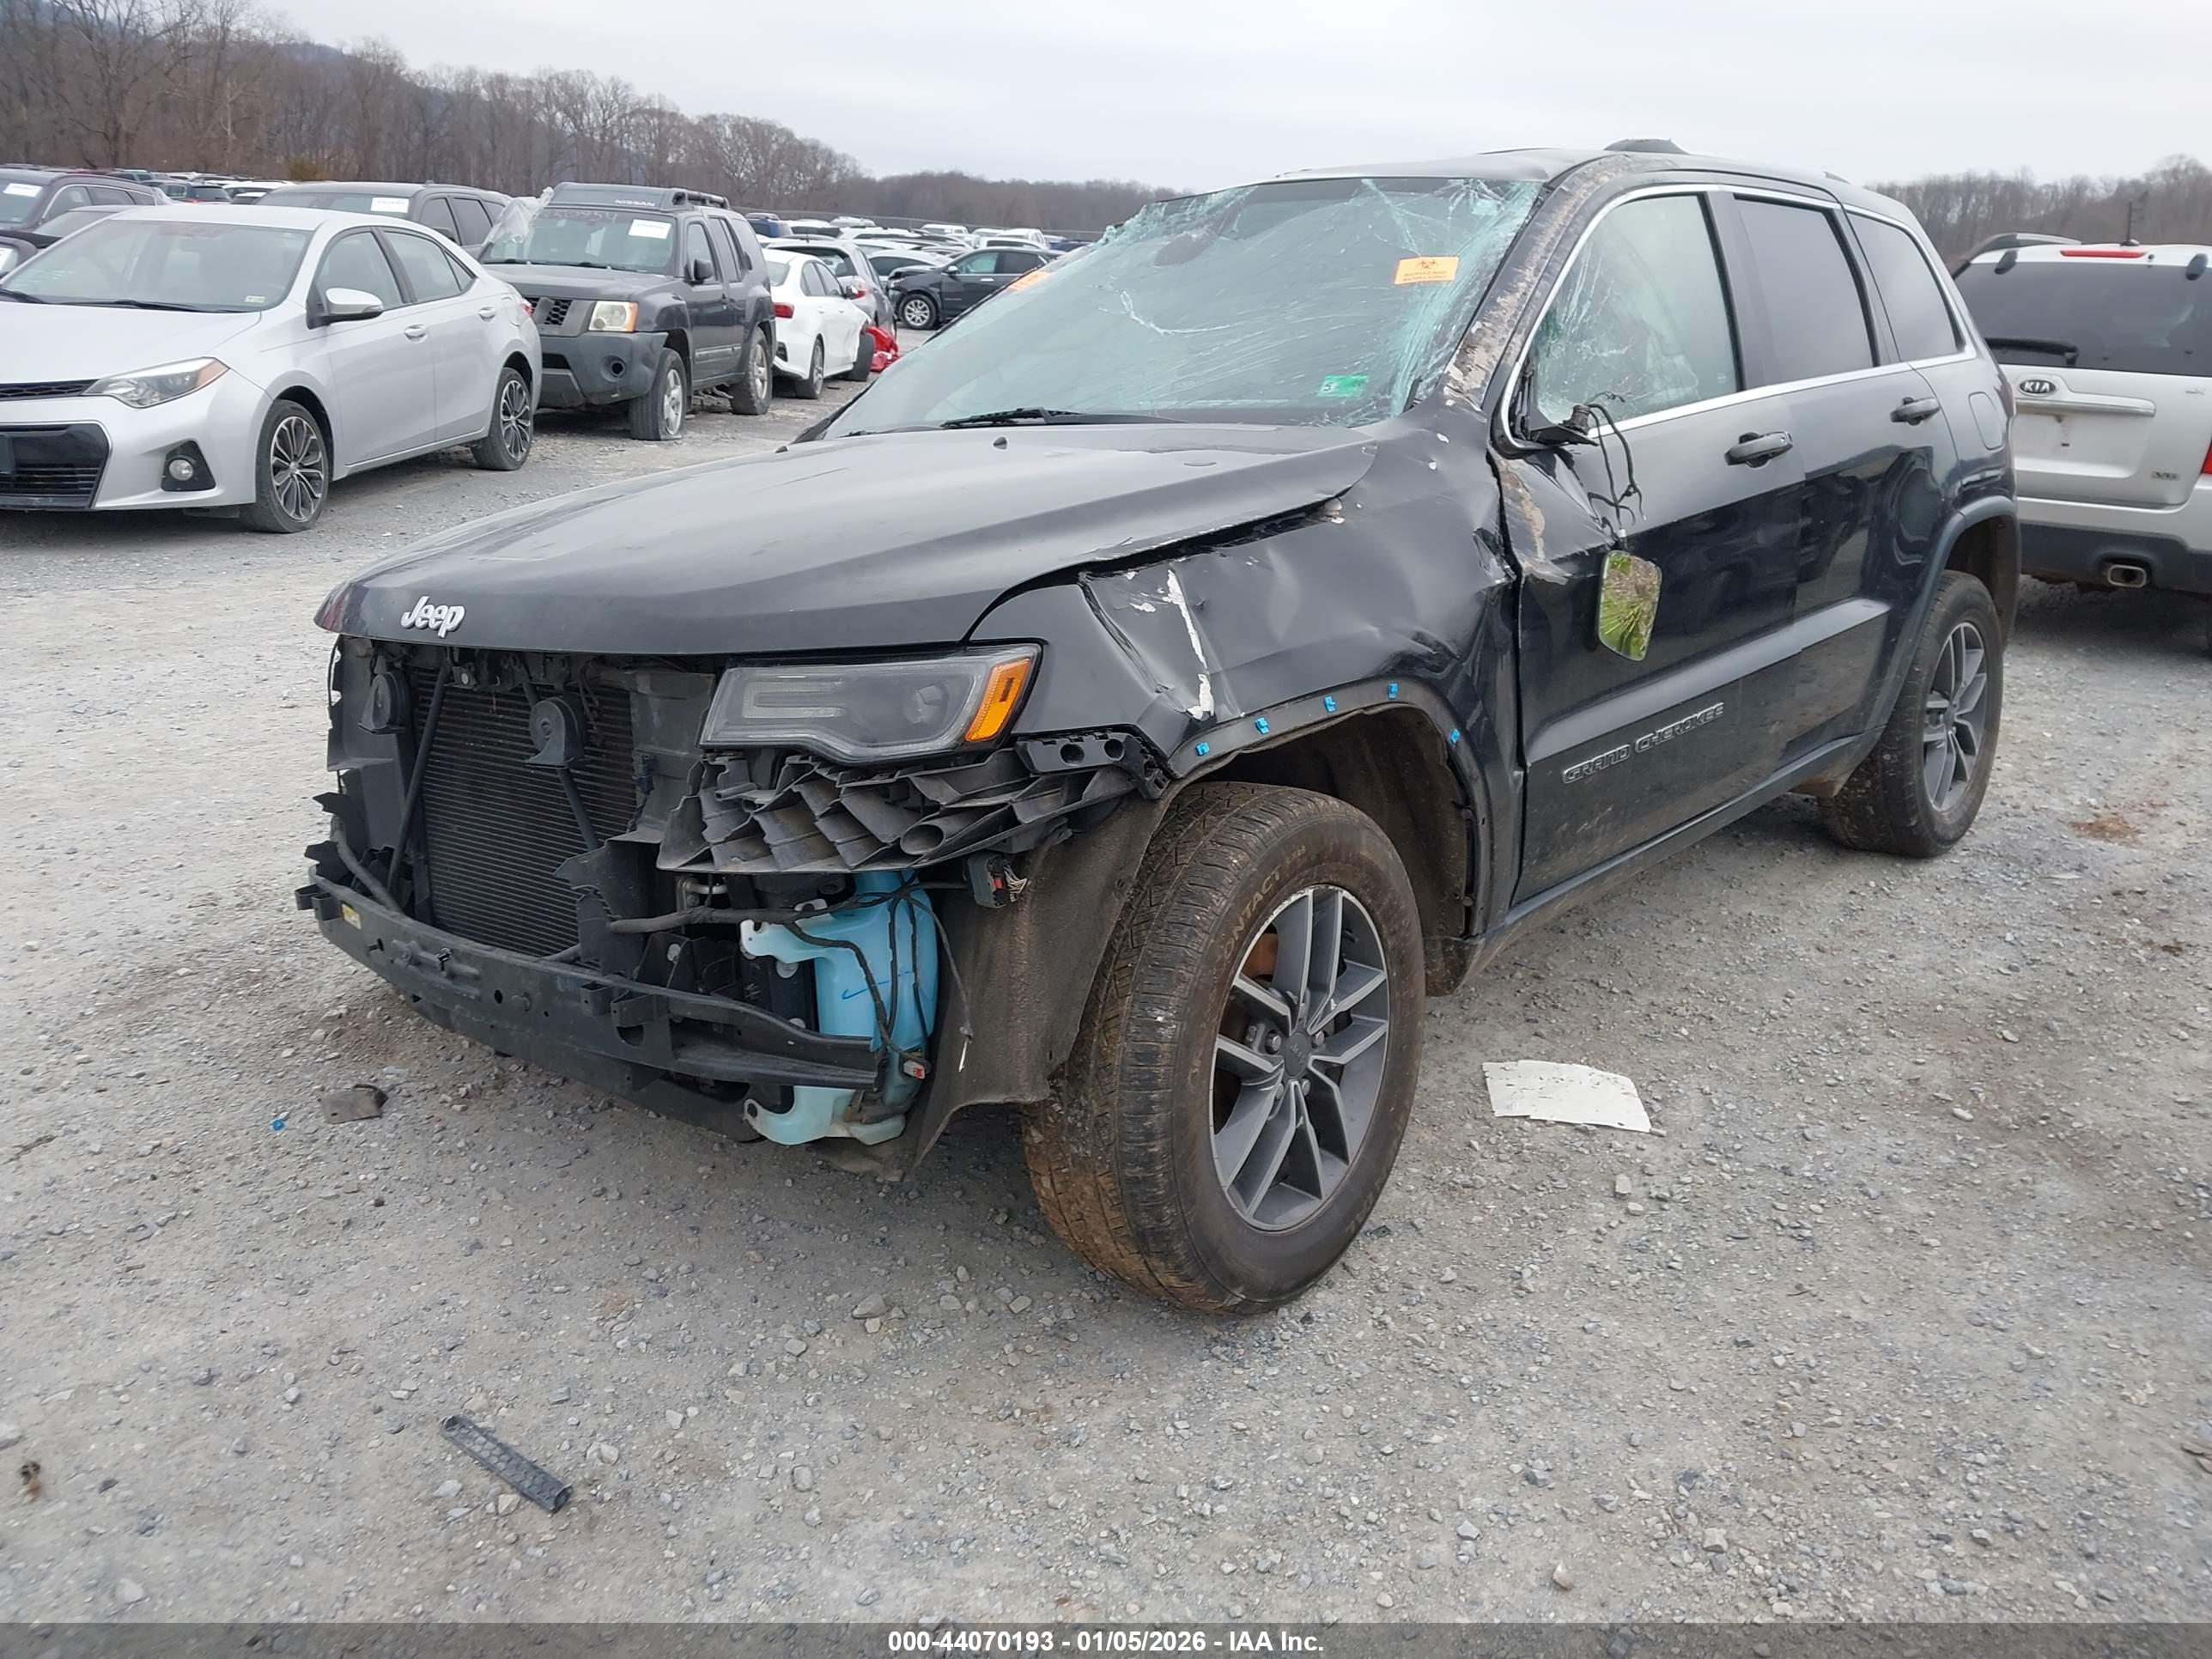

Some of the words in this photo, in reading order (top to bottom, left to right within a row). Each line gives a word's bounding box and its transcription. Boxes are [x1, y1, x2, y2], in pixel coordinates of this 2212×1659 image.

[615, 198, 655, 207] NISSAN
[2024, 380, 2051, 392] KIA
[400, 595, 465, 639] Jeep
[1562, 743, 1632, 784] GRAND
[1634, 701, 1725, 754] CHEROKEE
